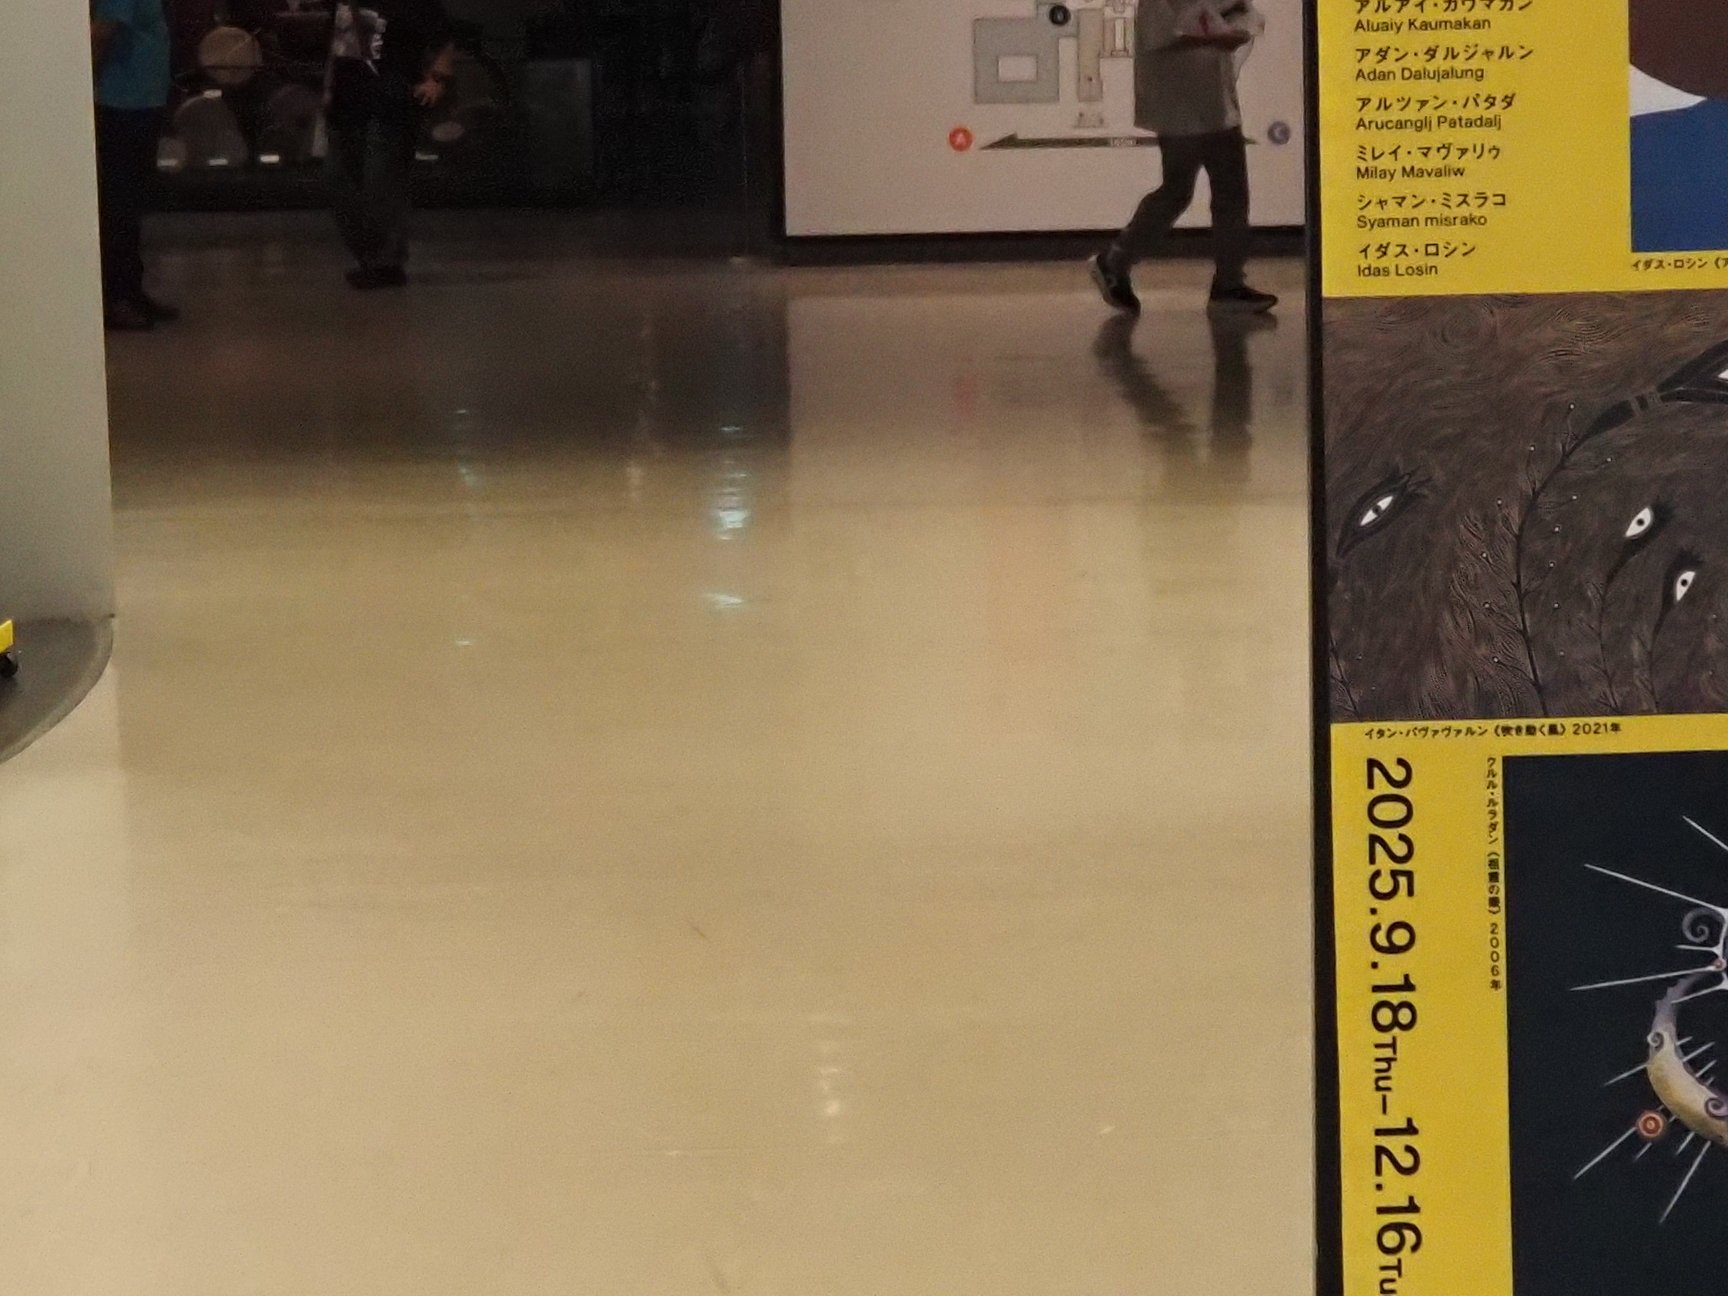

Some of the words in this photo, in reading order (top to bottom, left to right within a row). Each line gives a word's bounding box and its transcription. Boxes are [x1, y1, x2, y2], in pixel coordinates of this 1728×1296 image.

[1354, 18, 1403, 35] Aluaiy
[1407, 16, 1491, 32] Kaumakan
[1355, 43, 1535, 64] アダン・ダルジャルン
[1355, 67, 1396, 82] Adan
[1400, 66, 1485, 83] Dalujalung
[1356, 166, 1397, 182] Milay
[1401, 164, 1466, 180] Mavaliw
[1357, 191, 1507, 211] シャマン・ミスラコ
[1357, 215, 1420, 231] Syaman
[1424, 212, 1488, 228] misrako
[1358, 241, 1476, 260] イダス・ロシン
[1357, 264, 1390, 278] Idas
[1395, 263, 1439, 277] Losin
